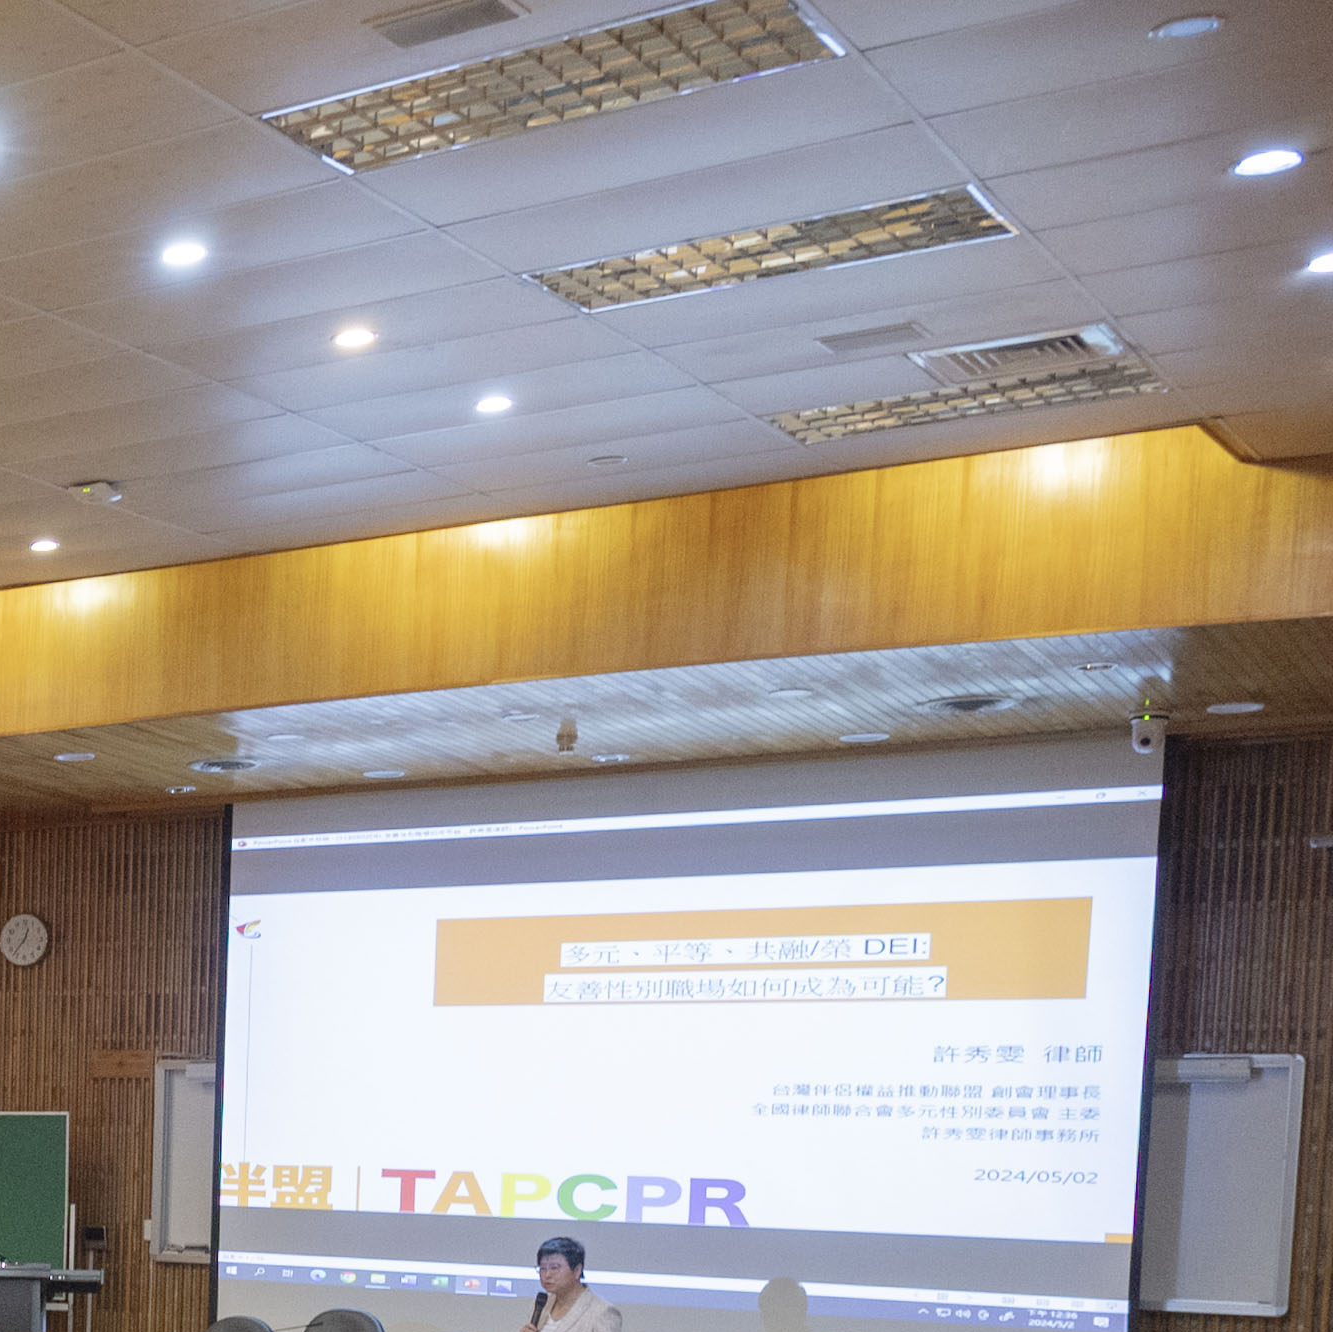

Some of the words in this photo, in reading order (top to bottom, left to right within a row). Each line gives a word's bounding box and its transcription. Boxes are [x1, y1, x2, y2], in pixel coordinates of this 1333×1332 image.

[864, 937, 928, 956] DEI:
[1044, 1045, 1104, 1065] 律師
[973, 1168, 1099, 1185] 2024/05/02
[381, 1167, 750, 1227] TAPCPR
